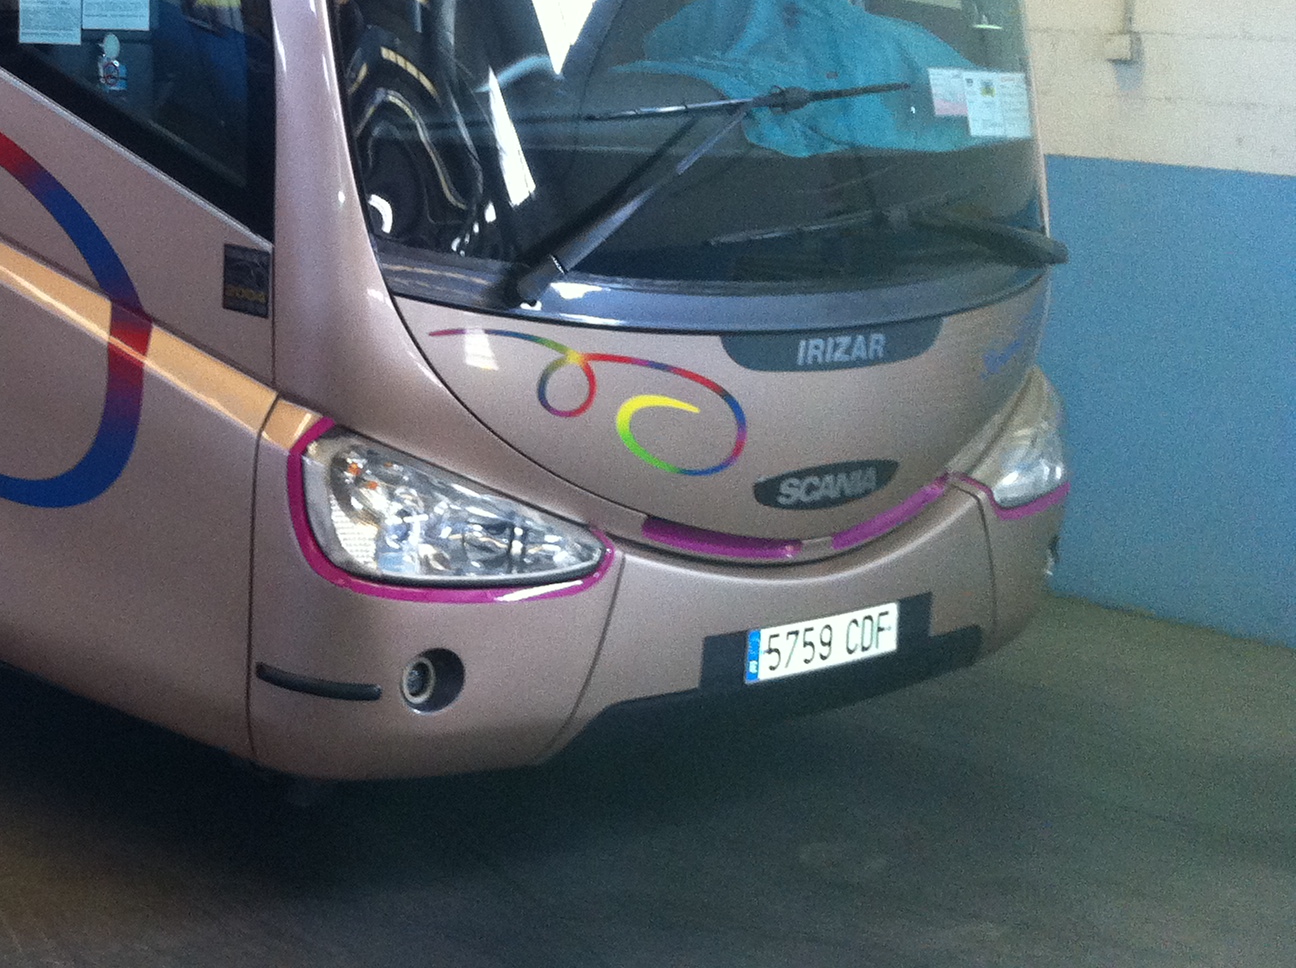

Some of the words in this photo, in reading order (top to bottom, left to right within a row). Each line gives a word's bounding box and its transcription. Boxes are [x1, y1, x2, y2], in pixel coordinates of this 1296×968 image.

[796, 333, 886, 367] IRIZAR
[776, 467, 878, 506] SCANIA
[766, 624, 834, 672] 5759
[845, 610, 890, 655] CDF
